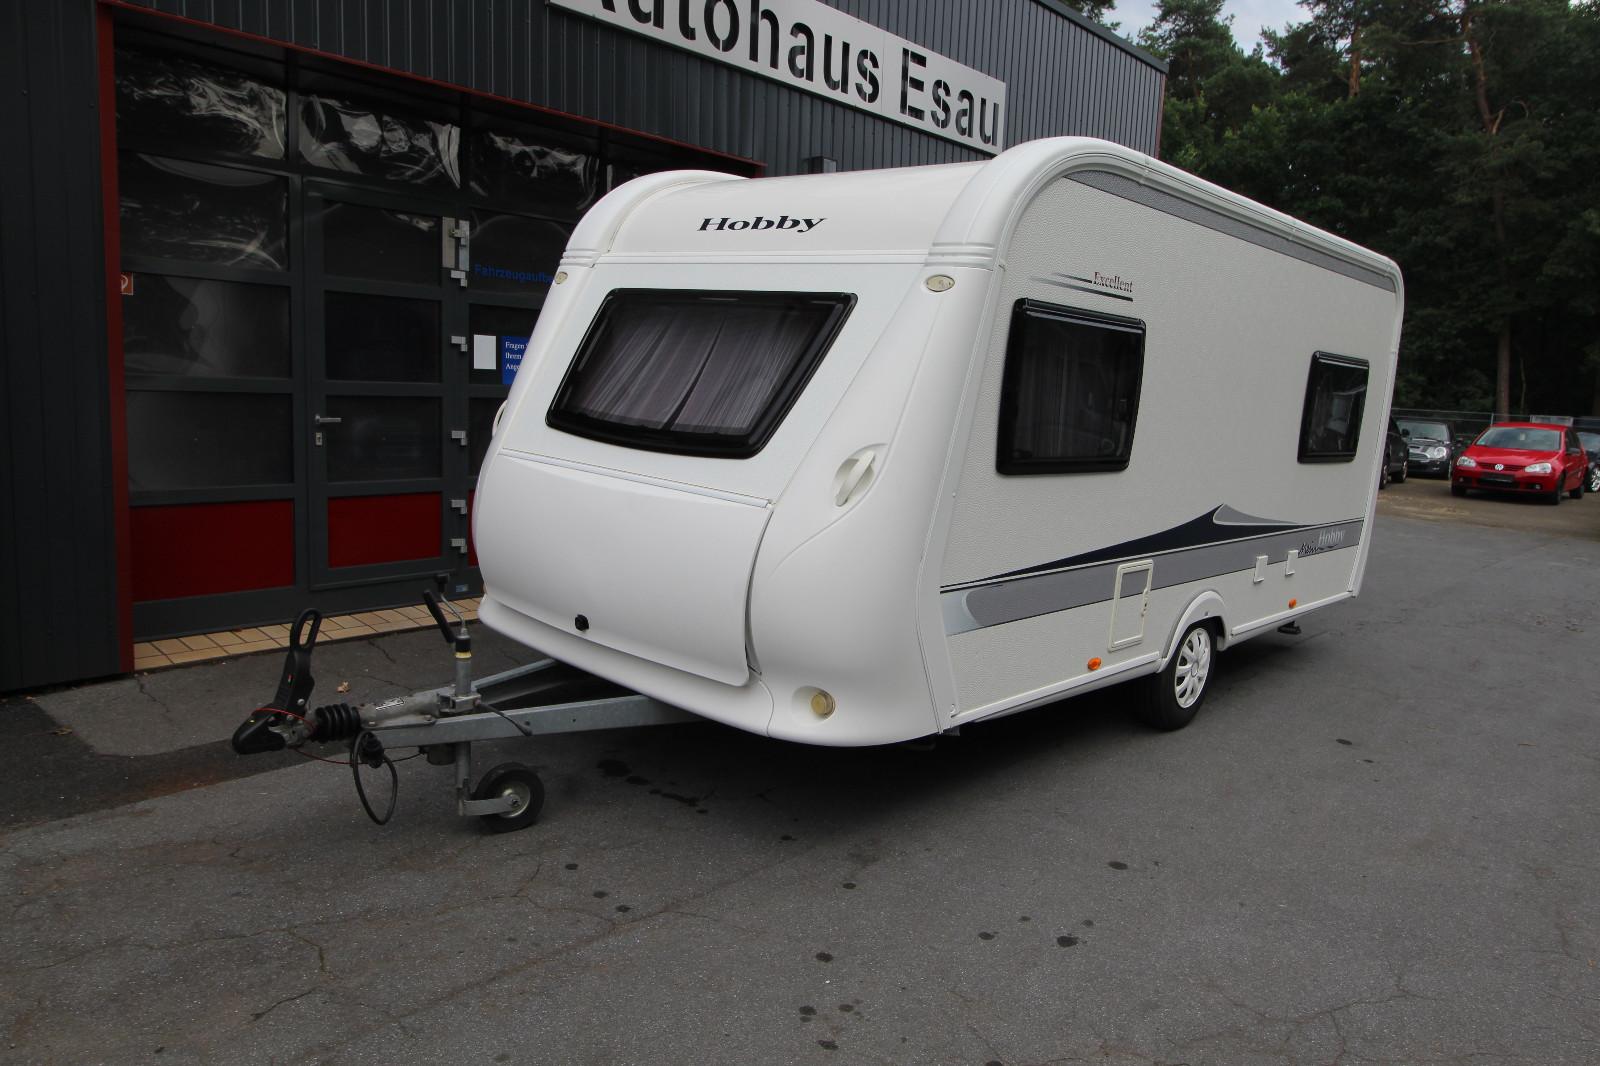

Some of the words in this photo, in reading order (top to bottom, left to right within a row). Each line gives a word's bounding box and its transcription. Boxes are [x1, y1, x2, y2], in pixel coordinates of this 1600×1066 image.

[900, 47, 999, 146] Esau
[697, 215, 827, 233] Hobby
[1093, 271, 1133, 293] Excellent
[505, 341, 525, 350] Fragen
[1318, 528, 1346, 545] Hobby
